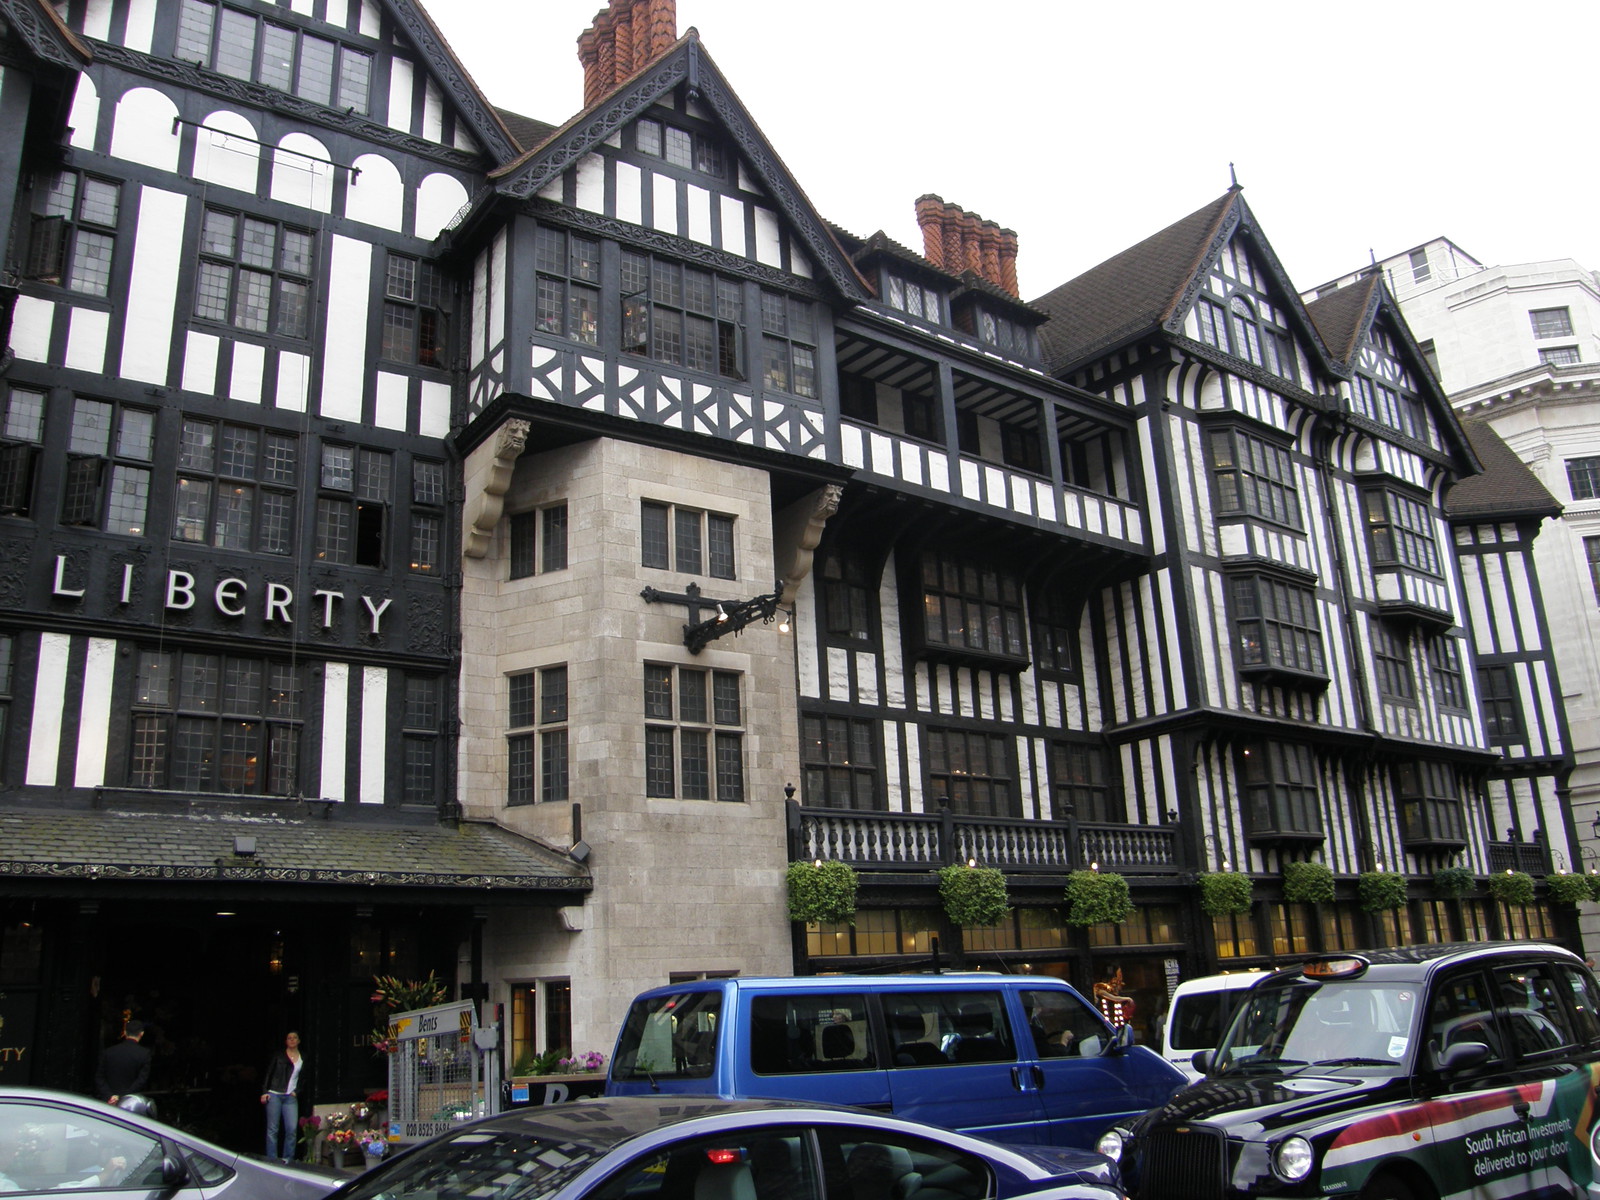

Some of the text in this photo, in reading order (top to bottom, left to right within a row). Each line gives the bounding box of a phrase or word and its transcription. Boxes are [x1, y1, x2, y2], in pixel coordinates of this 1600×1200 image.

[52, 555, 393, 634] LIBERTY
[418, 1015, 438, 1033] Bents
[406, 1123, 417, 1137] 020
[418, 1123, 433, 1137] 8525
[1465, 1118, 1572, 1155] South African Investment
[1474, 1139, 1572, 1176] delivered to your door.
